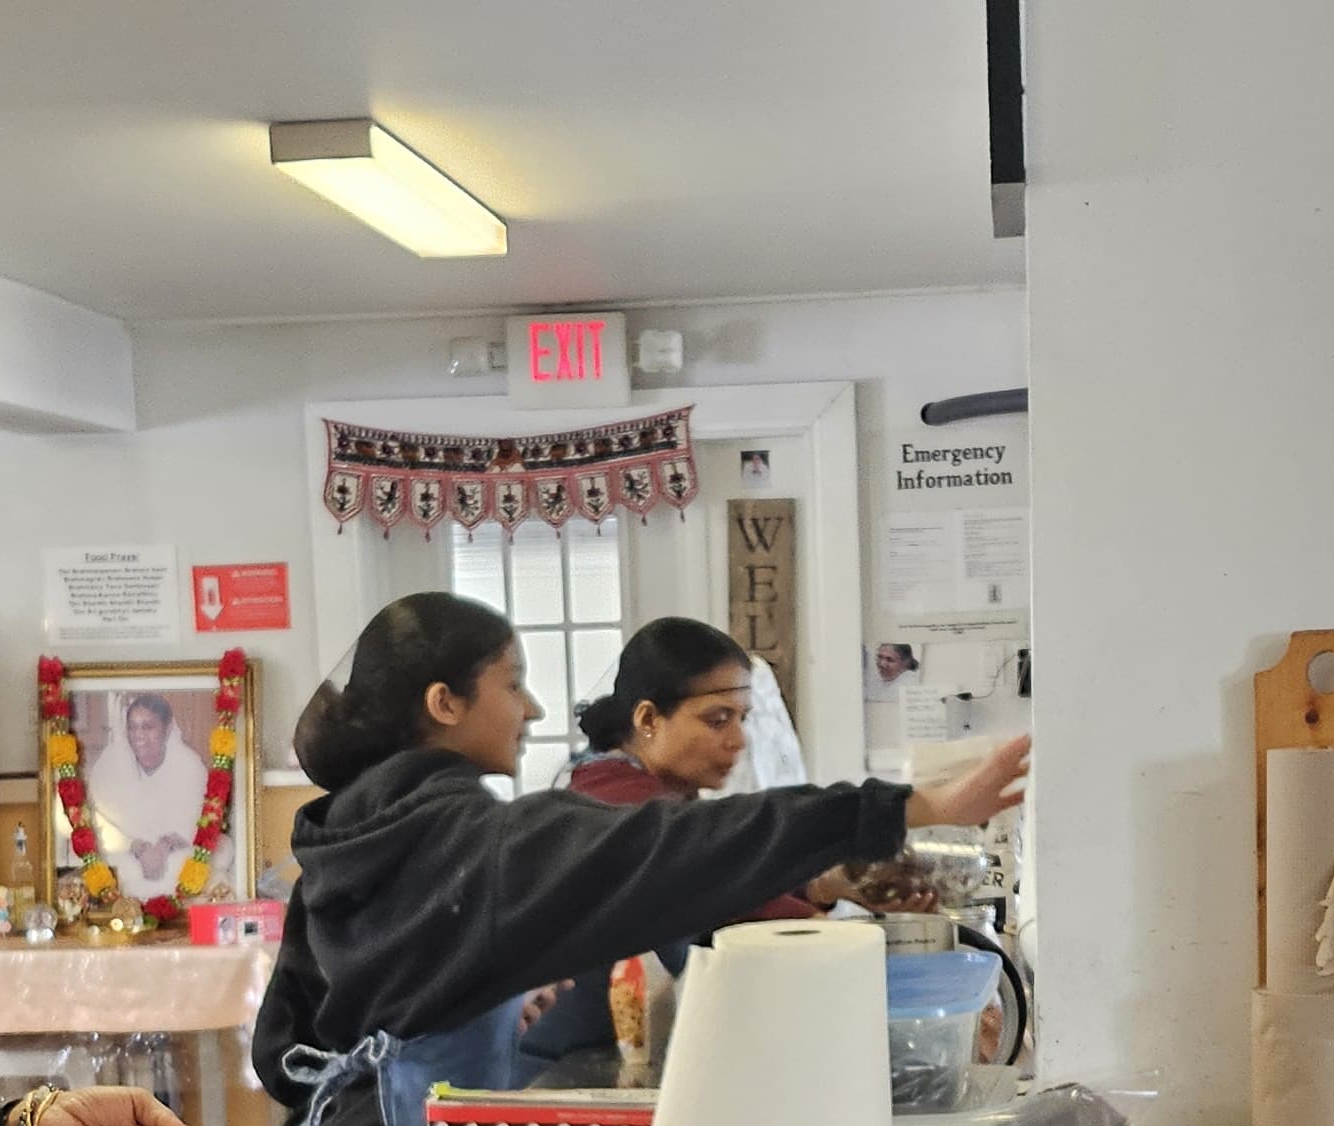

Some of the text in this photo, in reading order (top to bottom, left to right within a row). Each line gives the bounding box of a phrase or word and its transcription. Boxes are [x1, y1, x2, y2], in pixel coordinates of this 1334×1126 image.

[530, 322, 605, 381] EXIT
[901, 443, 1006, 466] Emergency
[896, 467, 1013, 490] Information
[737, 517, 785, 664] WEL
